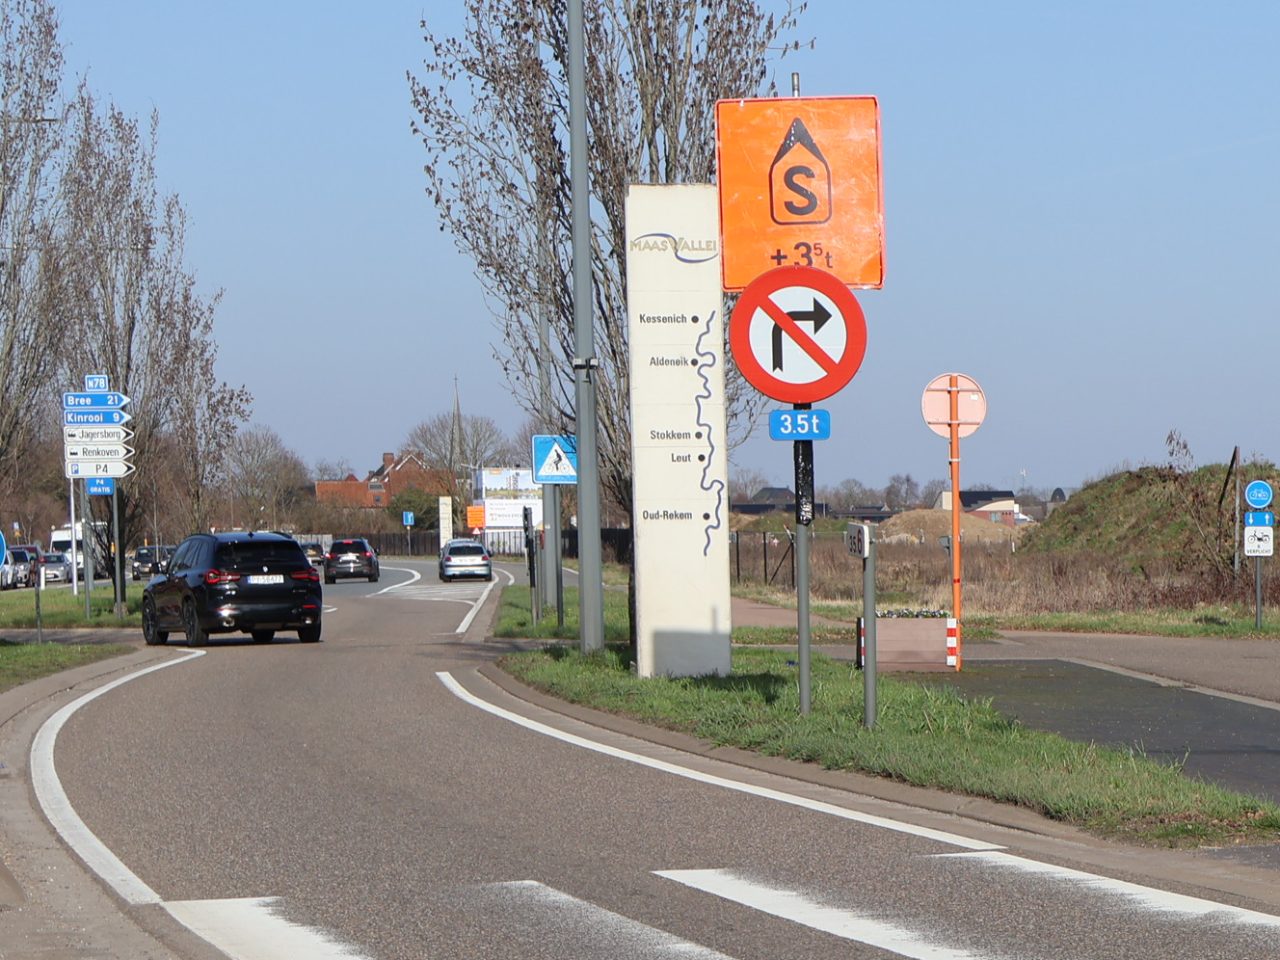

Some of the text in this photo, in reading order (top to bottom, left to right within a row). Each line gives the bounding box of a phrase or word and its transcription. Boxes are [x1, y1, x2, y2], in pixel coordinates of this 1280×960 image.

[783, 165, 818, 216] S
[630, 237, 717, 252] MAASVALLEI
[639, 313, 687, 324] Kessenich
[650, 356, 689, 367] Aldeneik
[88, 378, 105, 389] N78
[67, 395, 118, 405] Bree 21
[67, 413, 120, 422] Kinrooi 9
[650, 430, 691, 440] Stokkem
[82, 447, 119, 457] Renkoven
[671, 453, 691, 463] Leut
[95, 464, 108, 474] P4
[642, 510, 693, 520] Oud-Rekem
